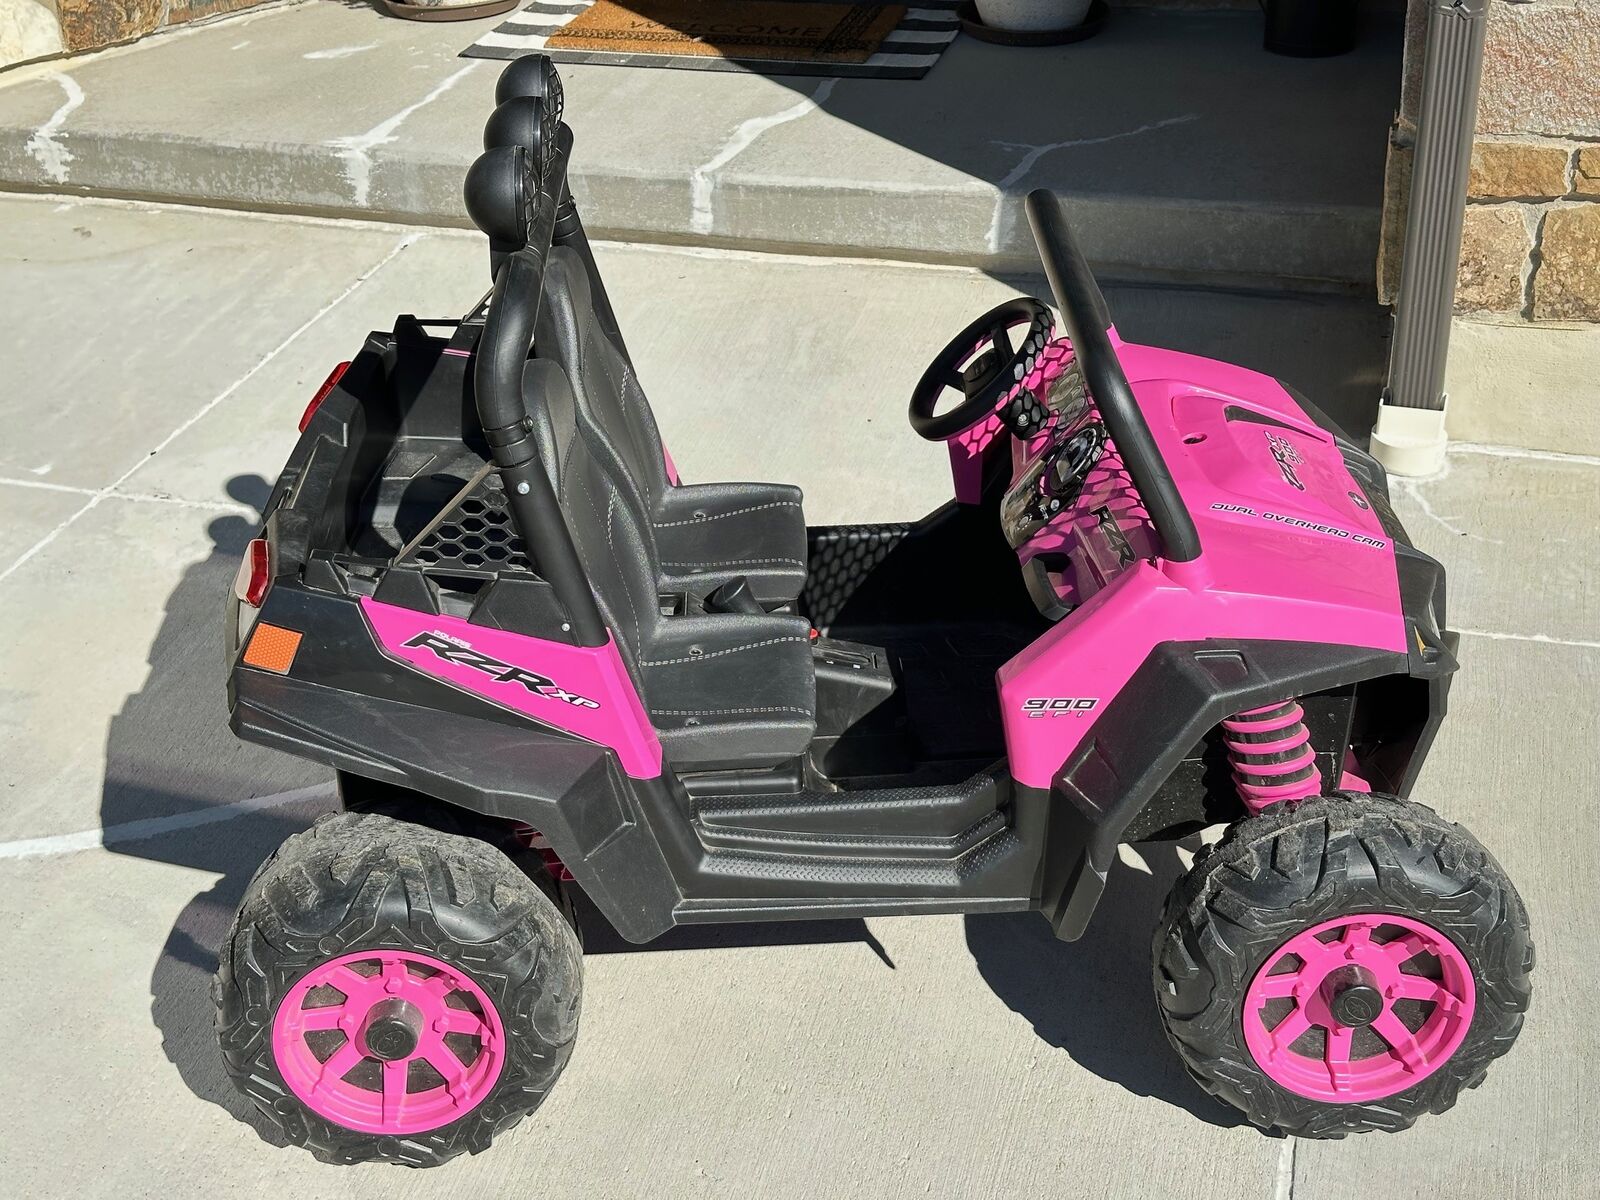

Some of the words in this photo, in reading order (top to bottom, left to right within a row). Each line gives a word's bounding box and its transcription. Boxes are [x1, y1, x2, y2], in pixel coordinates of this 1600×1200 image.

[630, 20, 823, 37] WELCOME
[1089, 505, 1136, 571] RZR
[1210, 502, 1258, 516] DUAL
[1262, 512, 1350, 538] OVERHEAD
[1351, 533, 1386, 549] CAM
[432, 629, 473, 649] POLARIS
[399, 631, 557, 699] RZR
[547, 688, 601, 710] XP
[1022, 698, 1099, 710] 900
